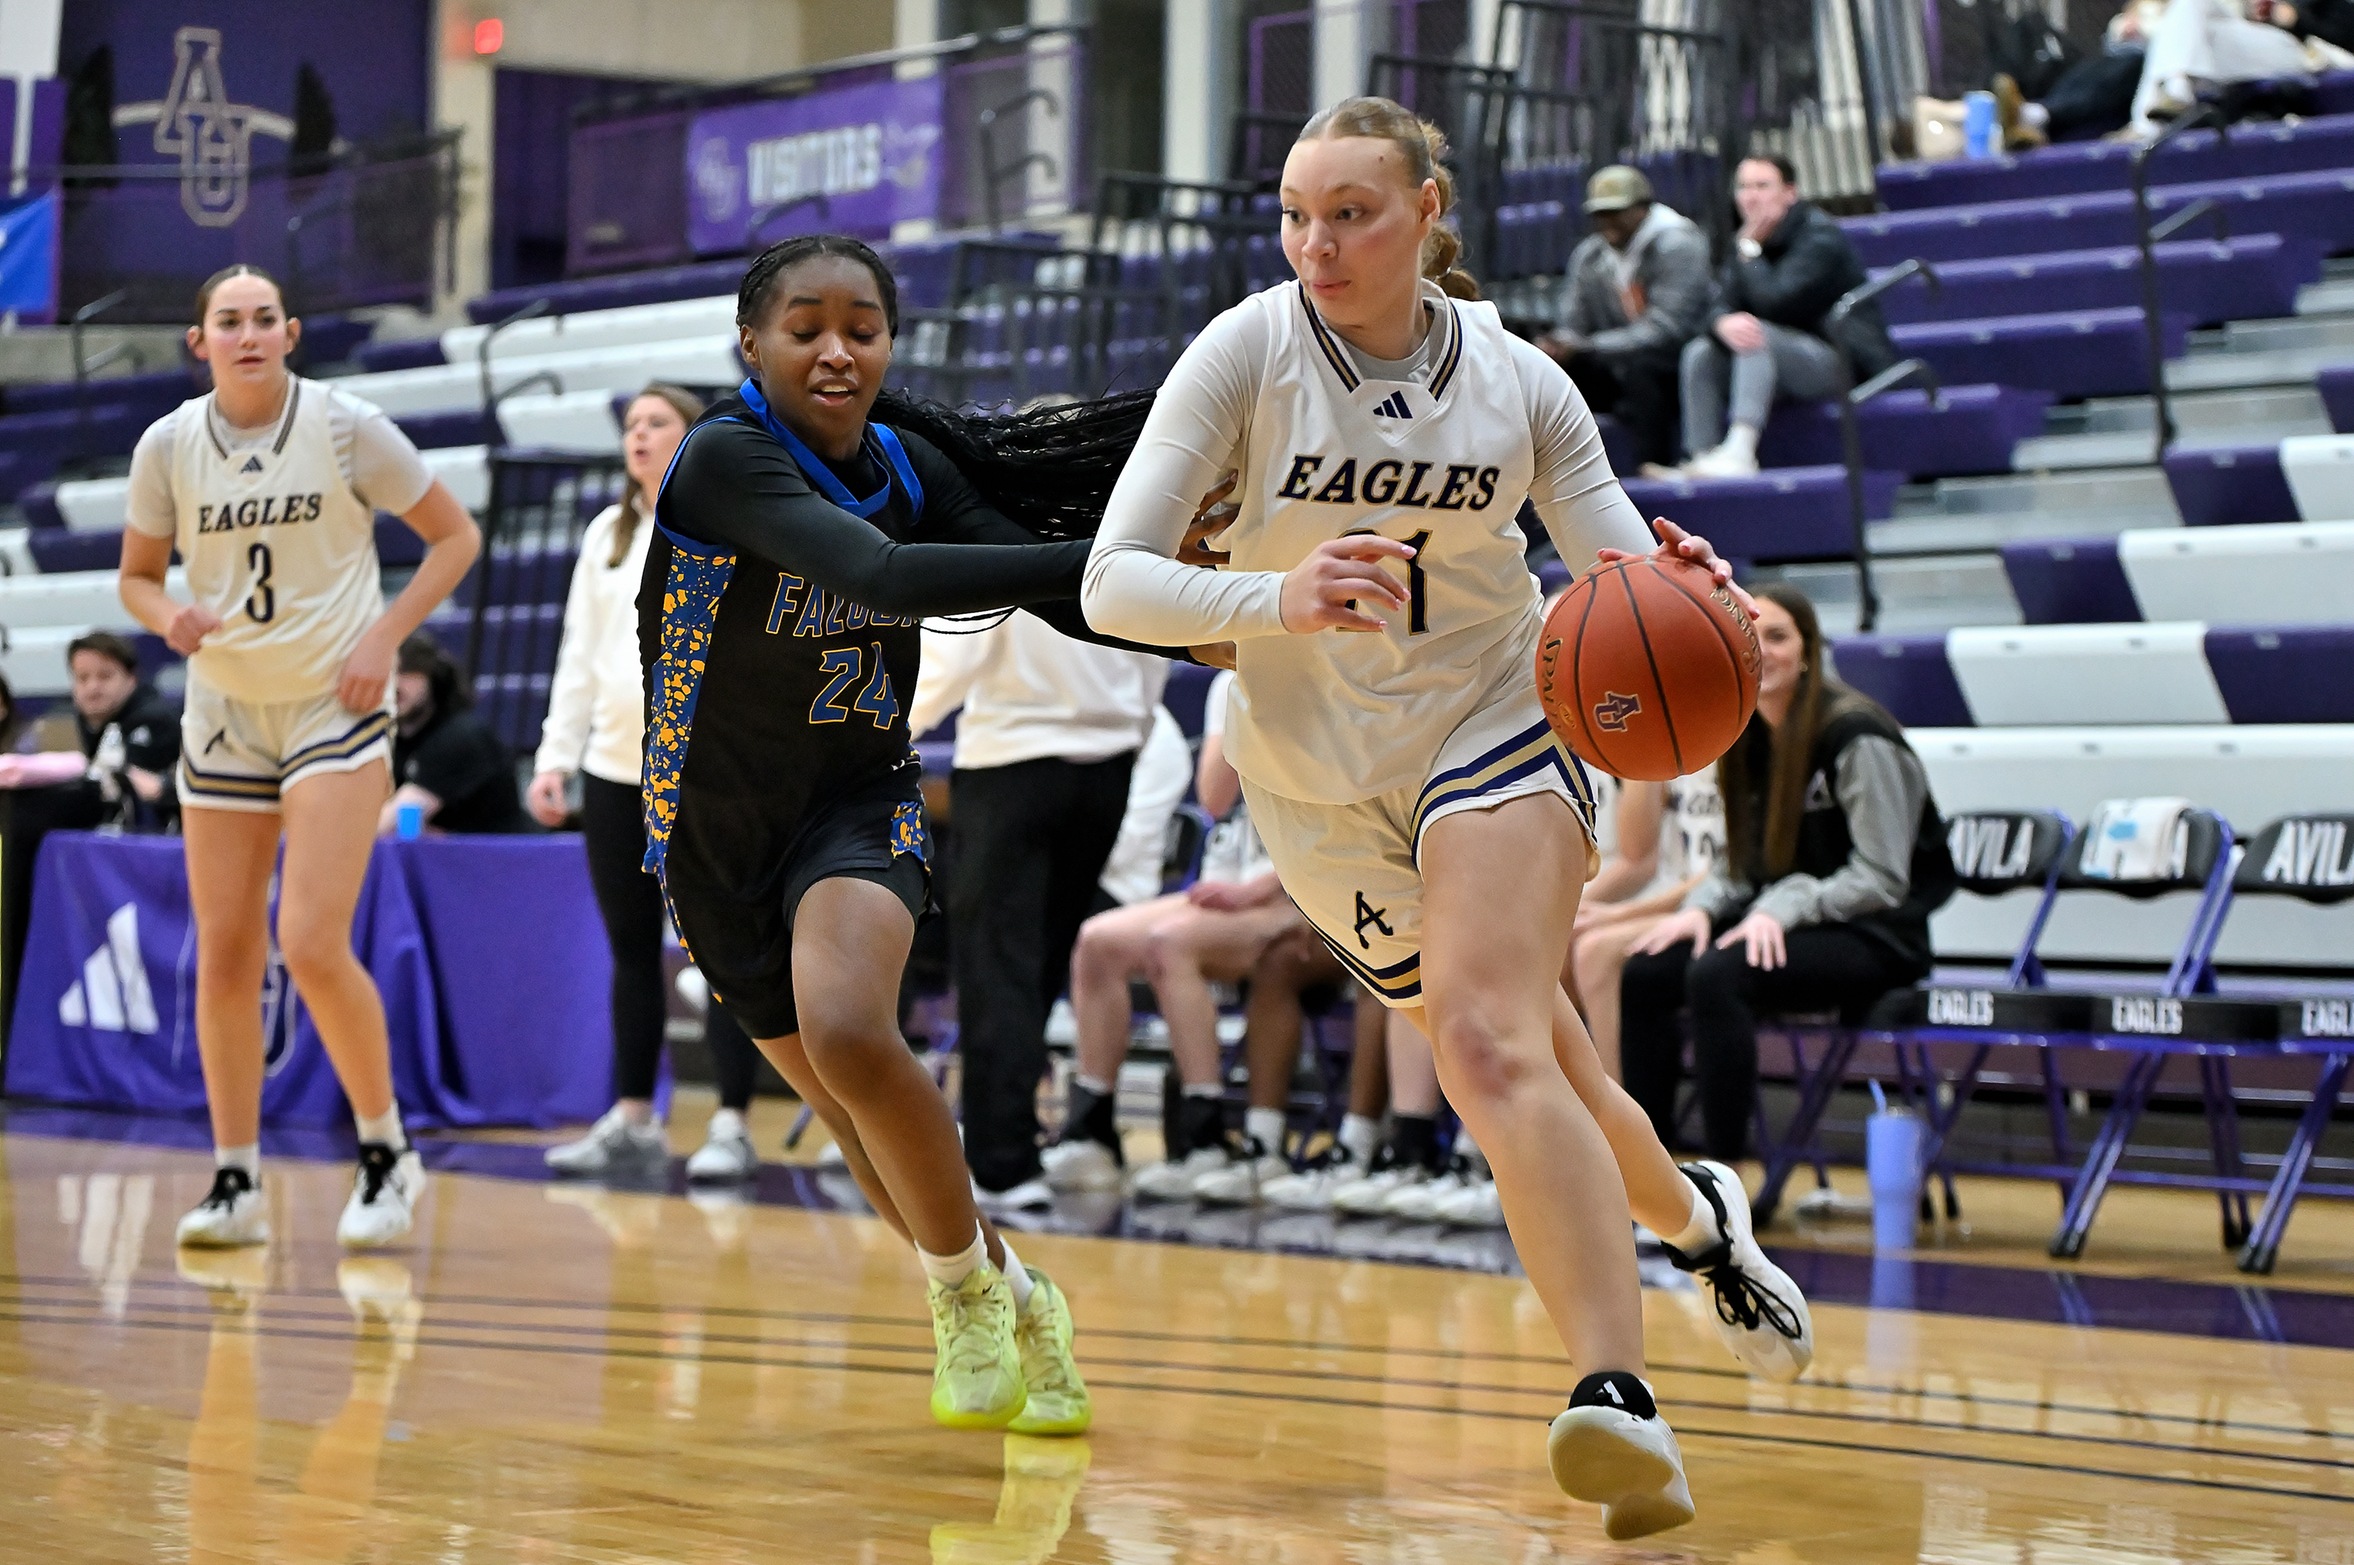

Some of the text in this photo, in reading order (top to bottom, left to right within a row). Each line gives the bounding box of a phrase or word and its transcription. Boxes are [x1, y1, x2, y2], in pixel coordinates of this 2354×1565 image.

[1276, 453, 1501, 511] EAGLES
[198, 493, 322, 534] EAGLES
[246, 542, 275, 623] 3
[1335, 527, 1434, 637] 1
[809, 641, 899, 731] 24
[1593, 691, 1642, 732] AU
[2261, 821, 2354, 887] AVIL
[1927, 989, 1994, 1026] EAGLES
[2111, 996, 2182, 1034] EAGLES
